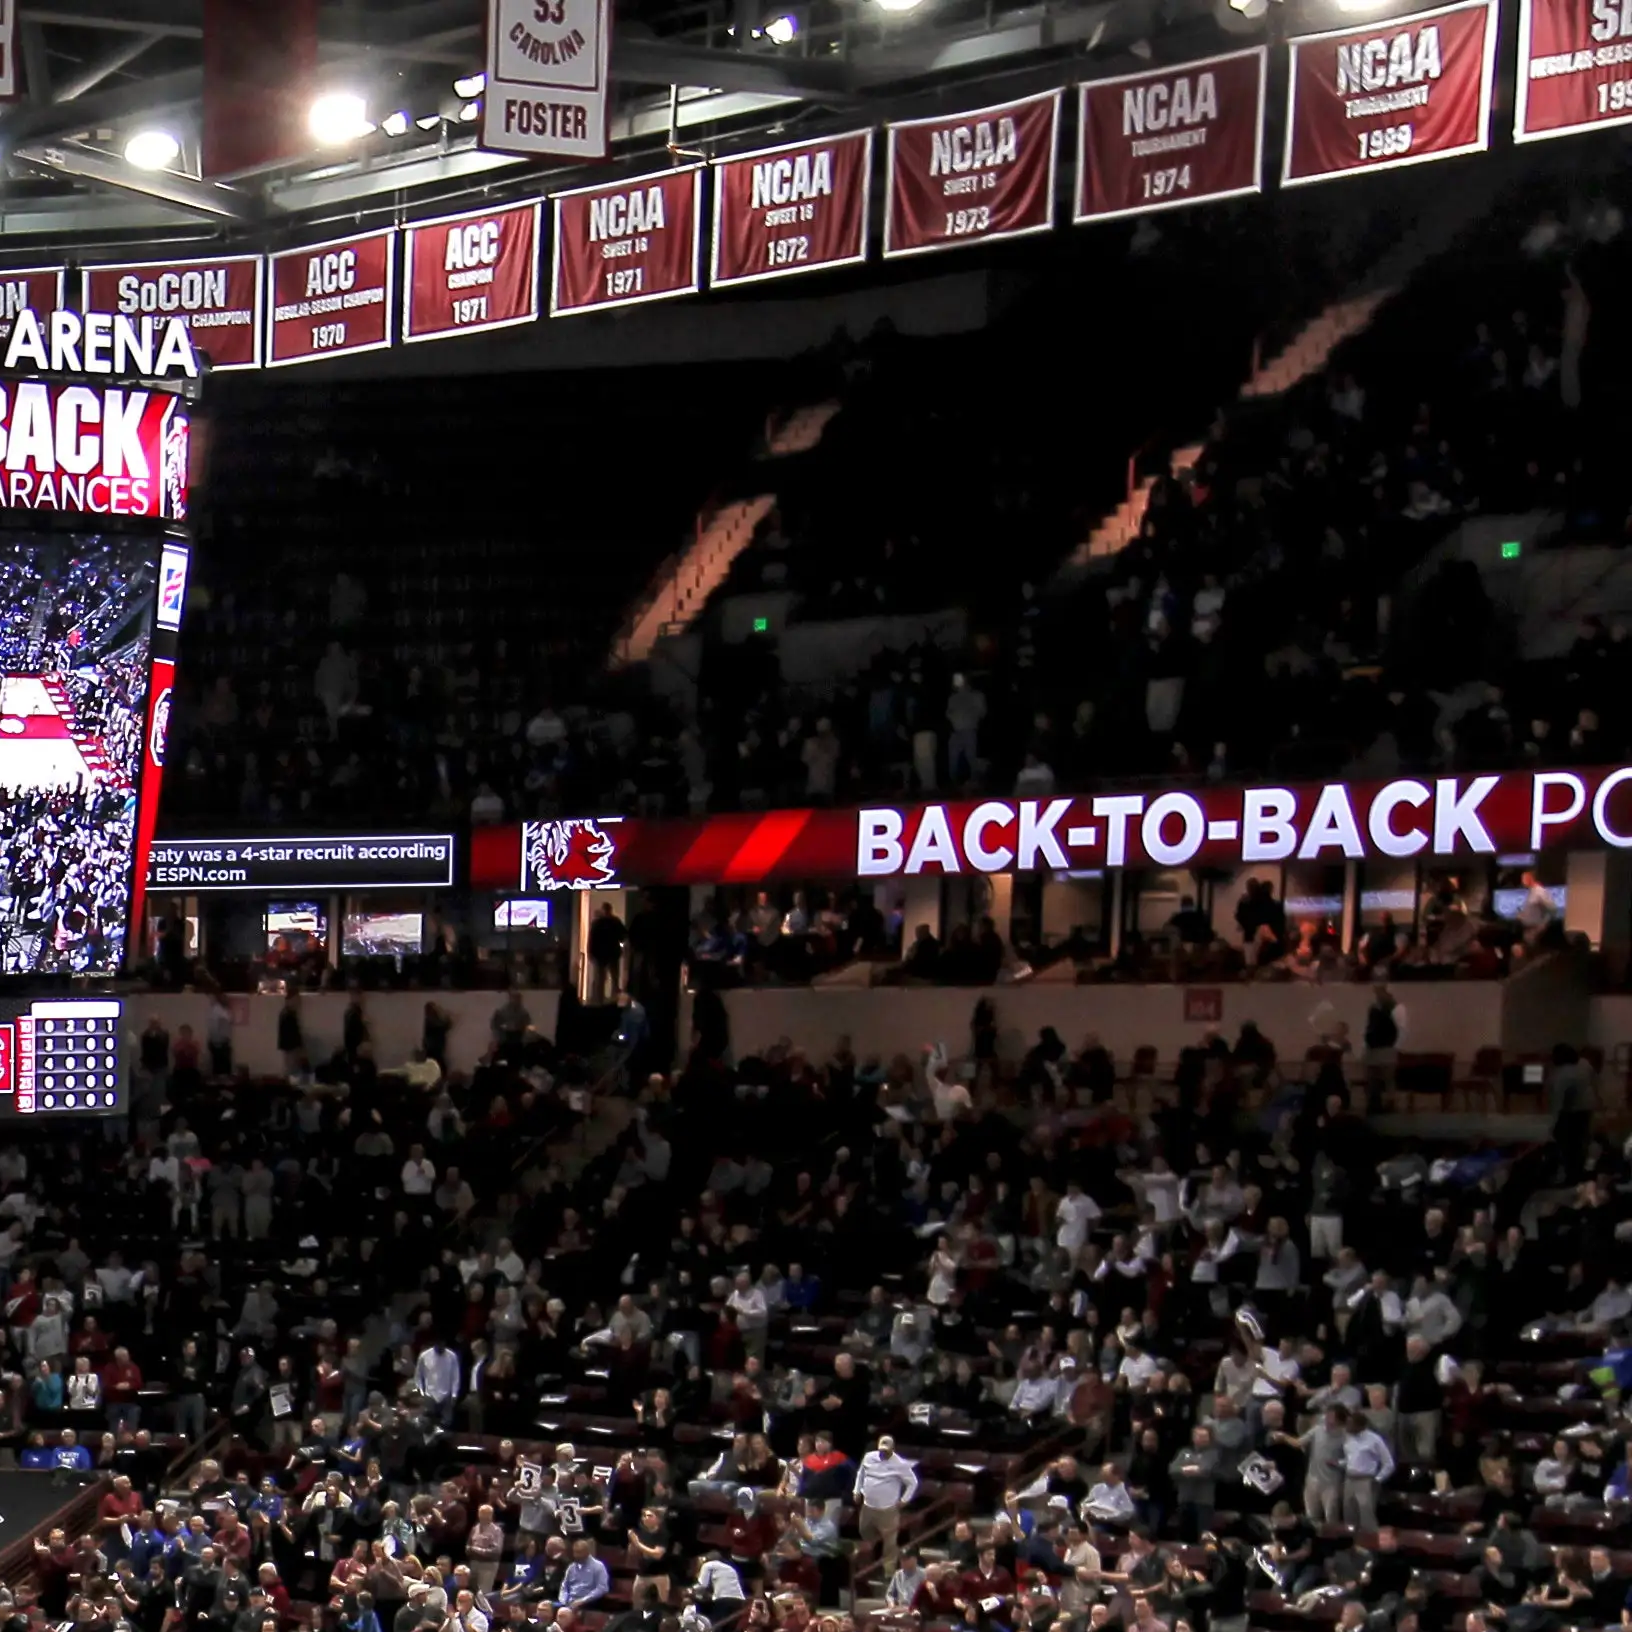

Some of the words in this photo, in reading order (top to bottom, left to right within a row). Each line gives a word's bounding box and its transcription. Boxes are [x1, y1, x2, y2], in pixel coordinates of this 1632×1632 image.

[509, 22, 586, 65] CAROLINA
[1337, 25, 1442, 97] NCAA
[1123, 72, 1217, 136] NCAA
[1345, 84, 1429, 118] TOURNAMENT
[505, 99, 588, 140] FOSTER
[930, 118, 1017, 176] NCAA
[1131, 129, 1206, 156] TOURNAMENT
[1357, 124, 1413, 159] 1989
[752, 152, 832, 209] NCAA
[1142, 165, 1190, 198] 1974
[590, 186, 664, 241] NCAA
[765, 207, 797, 227] SWEET
[945, 208, 990, 236] 1973
[445, 223, 499, 270] ACC
[768, 237, 807, 266] 1972
[305, 250, 355, 297] ACC
[447, 267, 494, 289] CHAMPION
[605, 269, 642, 296] 1971
[118, 270, 226, 313] SoCON
[192, 311, 251, 328] CHAMPION
[452, 297, 487, 324] 1971
[4, 308, 199, 378] ARENA
[312, 323, 346, 348] 1970
[857, 775, 1502, 877] BACK-TO-BACK
[148, 849, 184, 867] eaty
[187, 849, 222, 861] was
[225, 850, 237, 861] a
[241, 846, 293, 861] 4-star
[297, 844, 354, 860] recruit
[358, 843, 446, 863] according
[156, 867, 246, 883] ESPN.com
